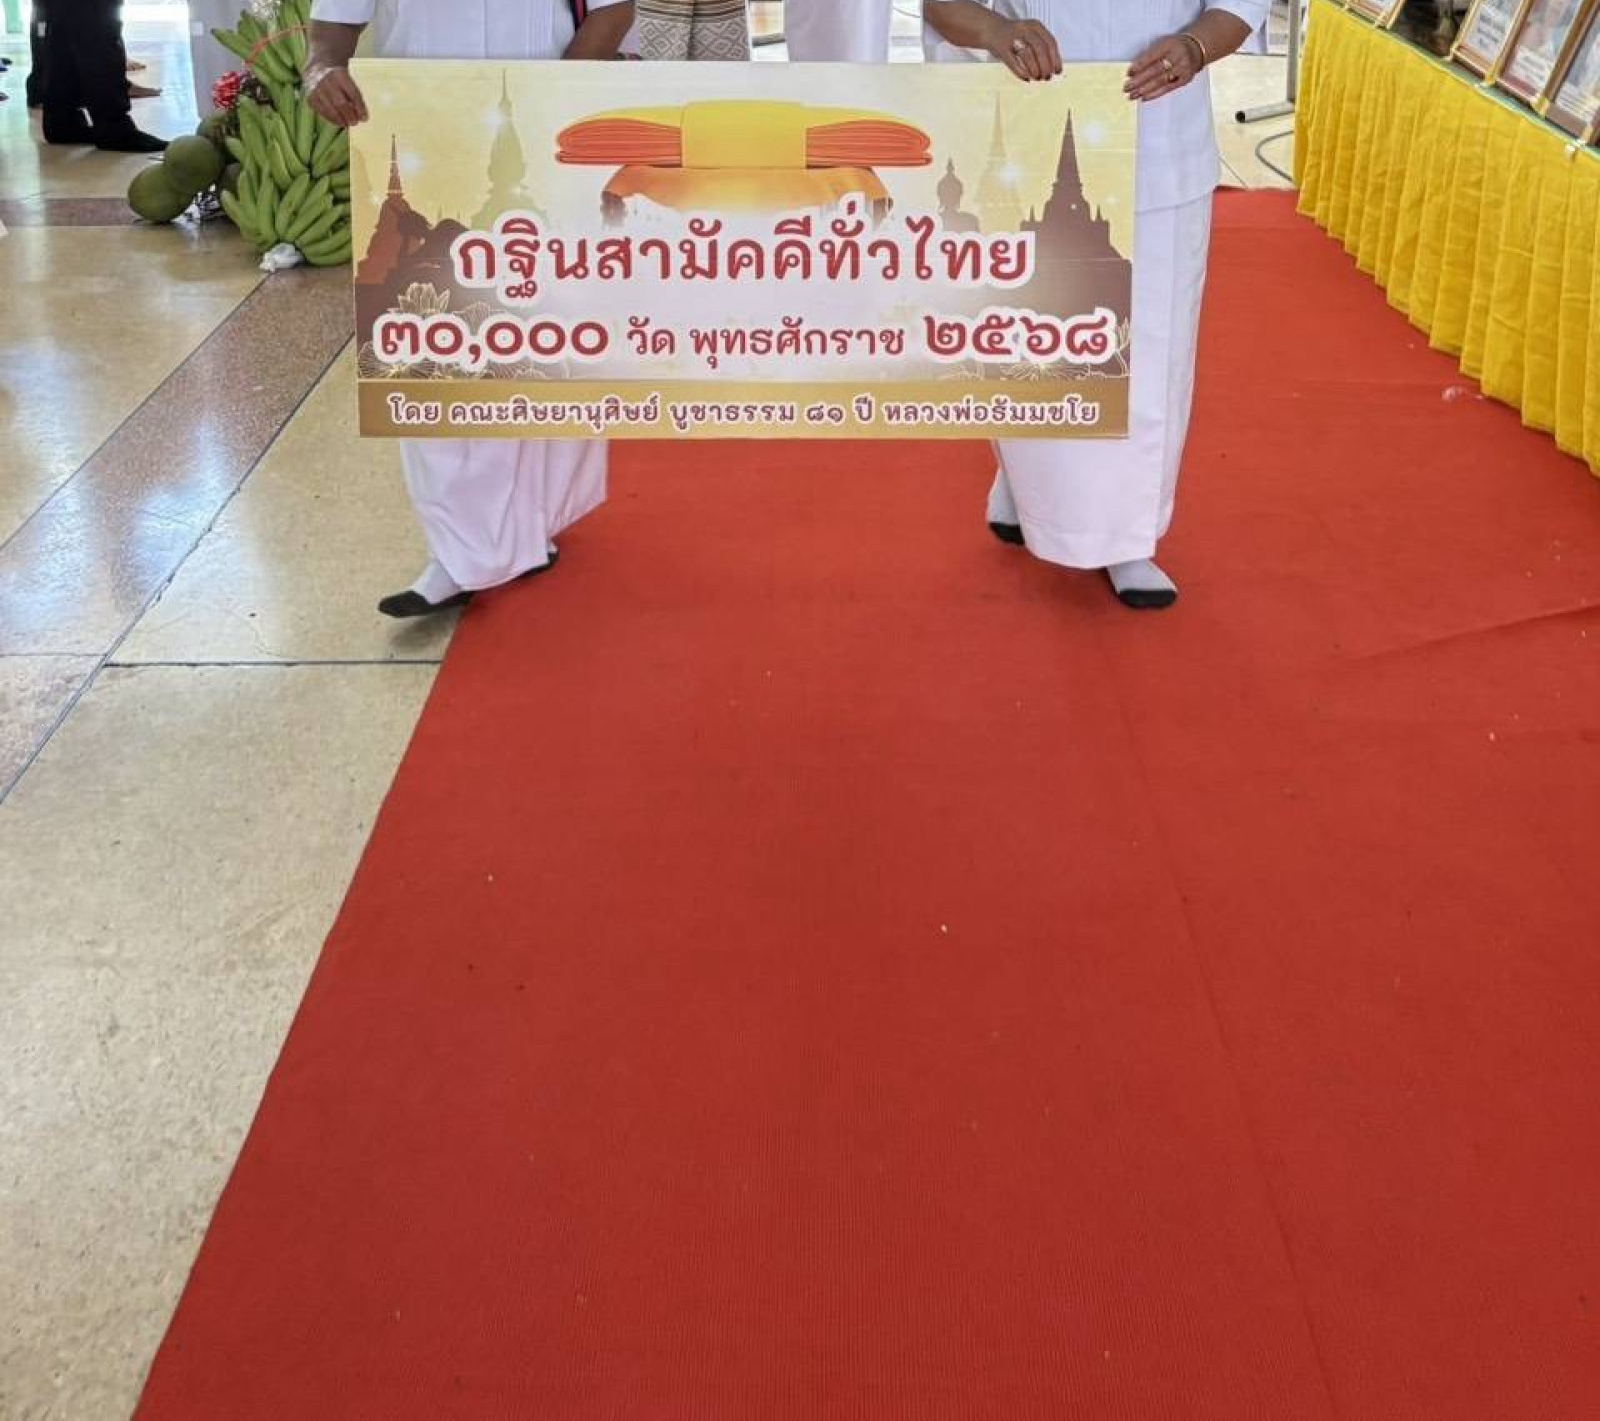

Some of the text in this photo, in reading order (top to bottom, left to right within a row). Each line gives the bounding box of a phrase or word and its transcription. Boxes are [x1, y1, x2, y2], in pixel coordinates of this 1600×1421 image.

[457, 200, 1028, 299] กฐินสามัคคีทั่วไทย
[379, 313, 1108, 370] ๓๐,๐๐๐ วัด พุทธศักราช ๒๕๖๘
[389, 393, 1098, 430] โดย คณะศิษยานุศิษย์ บูชาธรรม ๘๑ ปี หลวงพ่อธัมมชโย
